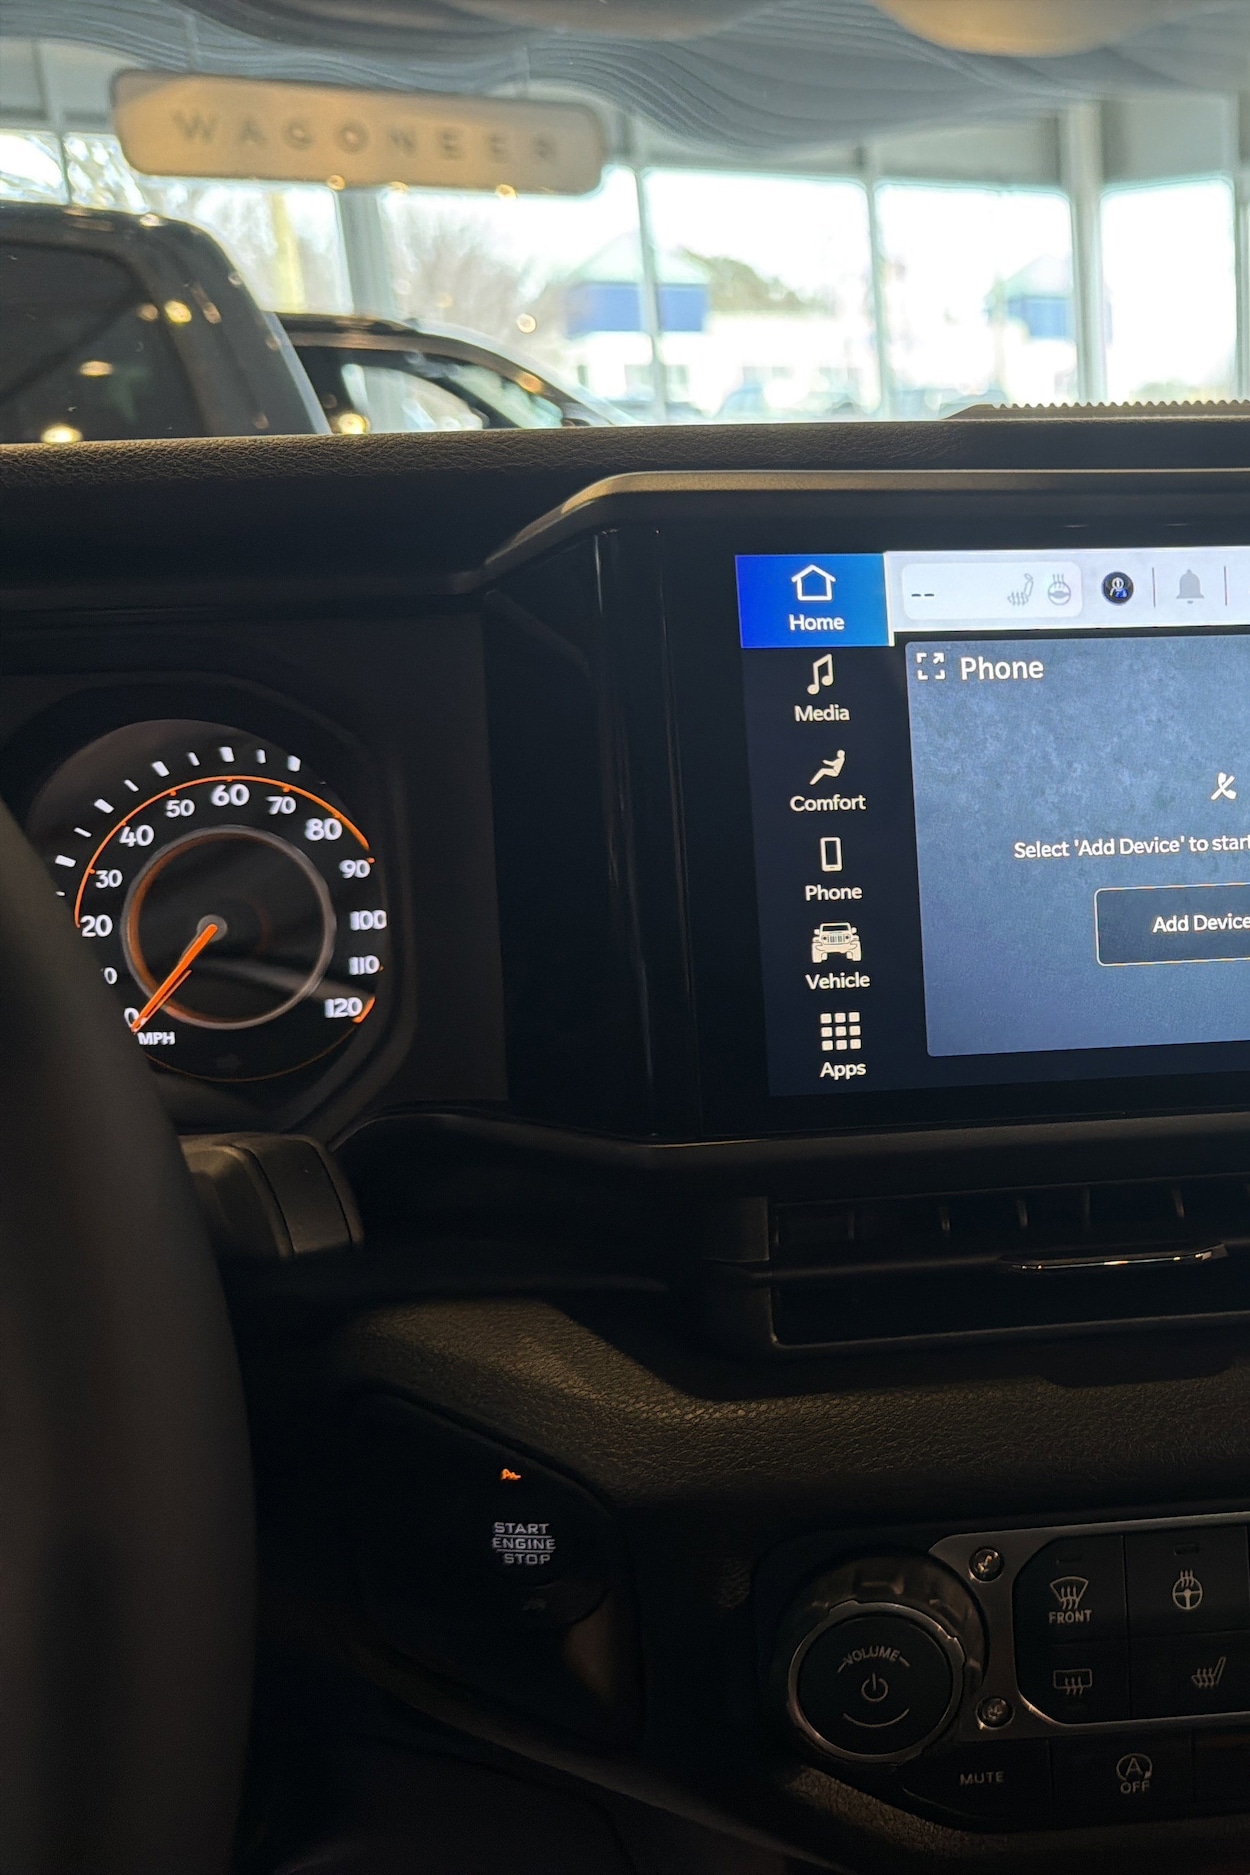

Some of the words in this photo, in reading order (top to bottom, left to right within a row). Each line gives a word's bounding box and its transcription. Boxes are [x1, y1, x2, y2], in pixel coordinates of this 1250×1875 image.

[788, 614, 845, 632] Home
[960, 656, 1045, 681] Phone
[795, 704, 850, 723] Media
[211, 783, 250, 806] 60
[789, 794, 867, 813] Comfort
[165, 799, 195, 818] 50
[266, 796, 297, 815] 70
[119, 825, 155, 847] 40
[305, 818, 342, 841] 80
[1014, 840, 1070, 859] Select
[1073, 838, 1116, 857] 'Add
[1119, 836, 1185, 854] Device'
[1188, 837, 1209, 852] to
[339, 859, 371, 878] 90
[95, 870, 123, 888] 30
[804, 883, 863, 903] Phone
[80, 915, 113, 937] 20
[350, 909, 387, 930] 100
[1152, 915, 1191, 933] Add
[348, 955, 380, 975] 110
[805, 971, 870, 991] Vehicle
[324, 997, 363, 1018] 120
[137, 1030, 175, 1046] MPH
[820, 1060, 867, 1080] Apps
[492, 1521, 550, 1535] START
[491, 1537, 556, 1551] ENGINE
[502, 1552, 551, 1566] STOP
[1048, 1609, 1092, 1625] FRONT
[843, 1645, 900, 1667] VOLUME
[960, 1770, 1005, 1786] MUTE
[1120, 1780, 1150, 1795] OFF
